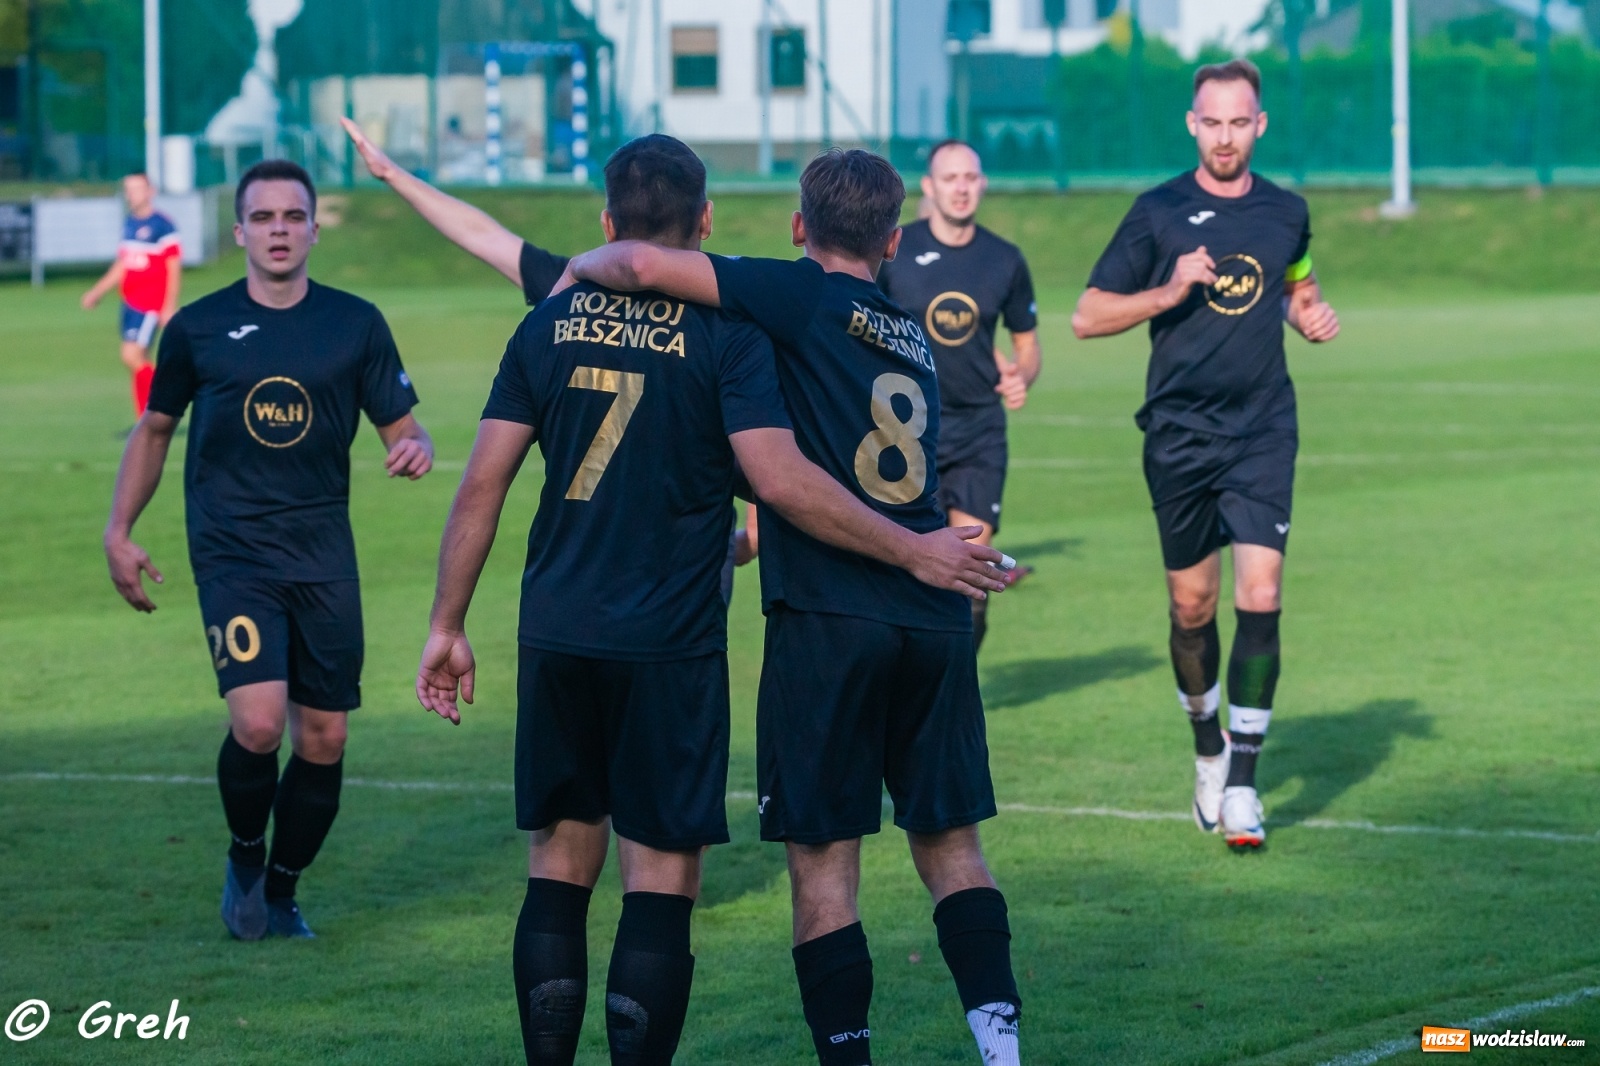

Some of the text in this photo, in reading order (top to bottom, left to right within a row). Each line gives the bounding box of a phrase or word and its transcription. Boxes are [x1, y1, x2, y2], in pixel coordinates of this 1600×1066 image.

[554, 317, 685, 358] BEŁSZNICA
[254, 402, 304, 422] W&H
[564, 366, 645, 501] 7
[854, 372, 927, 504] 8
[207, 615, 261, 671] 20
[998, 1027, 1018, 1036] PUM
